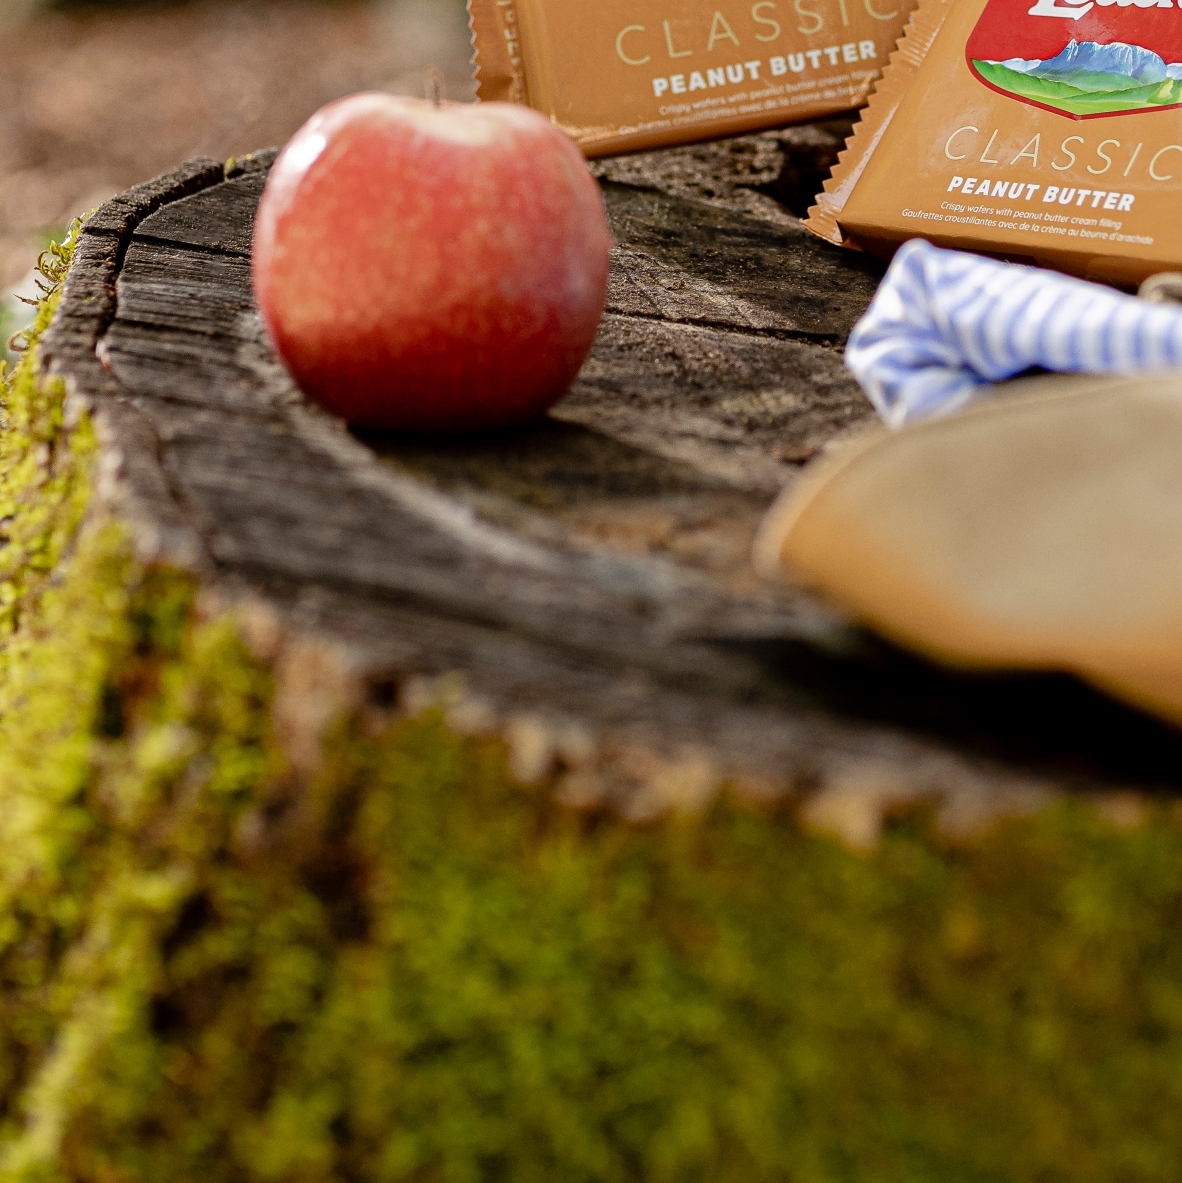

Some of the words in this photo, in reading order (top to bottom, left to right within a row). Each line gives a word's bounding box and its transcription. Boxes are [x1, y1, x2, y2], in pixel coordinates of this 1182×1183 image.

[652, 60, 762, 97] PEANUT
[769, 40, 878, 77] BUTTER
[947, 176, 1040, 201] PEANUT
[1042, 186, 1135, 212] BUTTER
[902, 208, 943, 221] Gaufrettes
[944, 215, 997, 227] croustillantes
[997, 220, 1018, 230] avec
[1019, 222, 1031, 231] de
[1031, 223, 1041, 232] la
[1041, 224, 1067, 235] crème
[1068, 228, 1079, 236] au
[1080, 228, 1109, 240] beurre
[940, 201, 966, 213] Crispy
[967, 205, 994, 216] wafers
[995, 208, 1013, 218] with
[1013, 209, 1043, 221] peanut
[1043, 212, 1071, 224] butter
[1070, 216, 1098, 226] cream
[1098, 218, 1123, 230] filling
